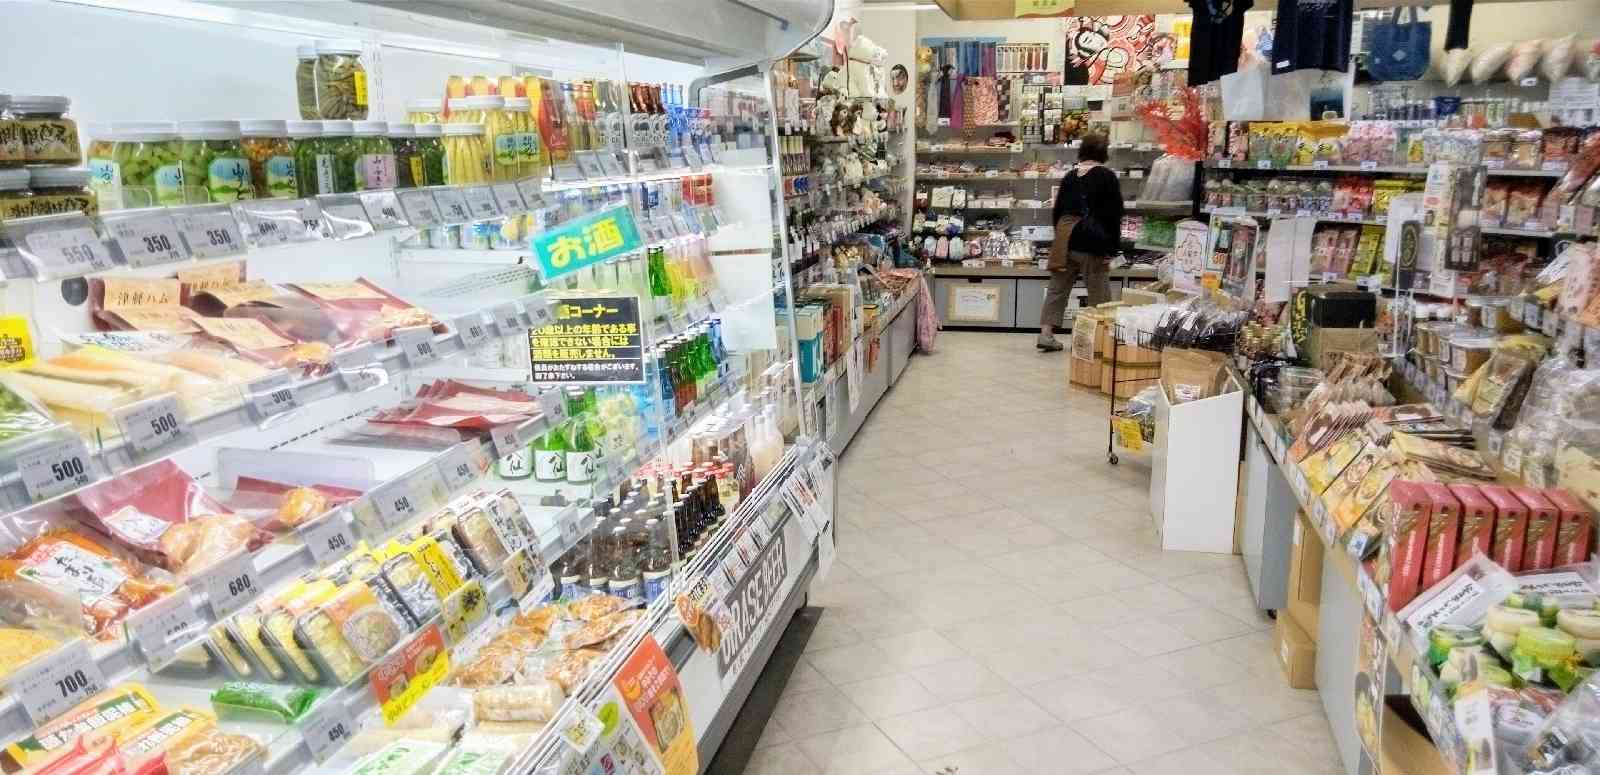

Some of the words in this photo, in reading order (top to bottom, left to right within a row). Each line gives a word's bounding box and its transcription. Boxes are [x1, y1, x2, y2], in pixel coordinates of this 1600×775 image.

[143, 234, 172, 254] 350
[207, 228, 232, 246] 350
[548, 217, 625, 268] お酒
[150, 412, 178, 437] 500
[51, 456, 85, 483] 500
[394, 495, 410, 512] 450
[327, 532, 347, 552] 450
[227, 573, 252, 597] 680
[56, 668, 88, 698] 700
